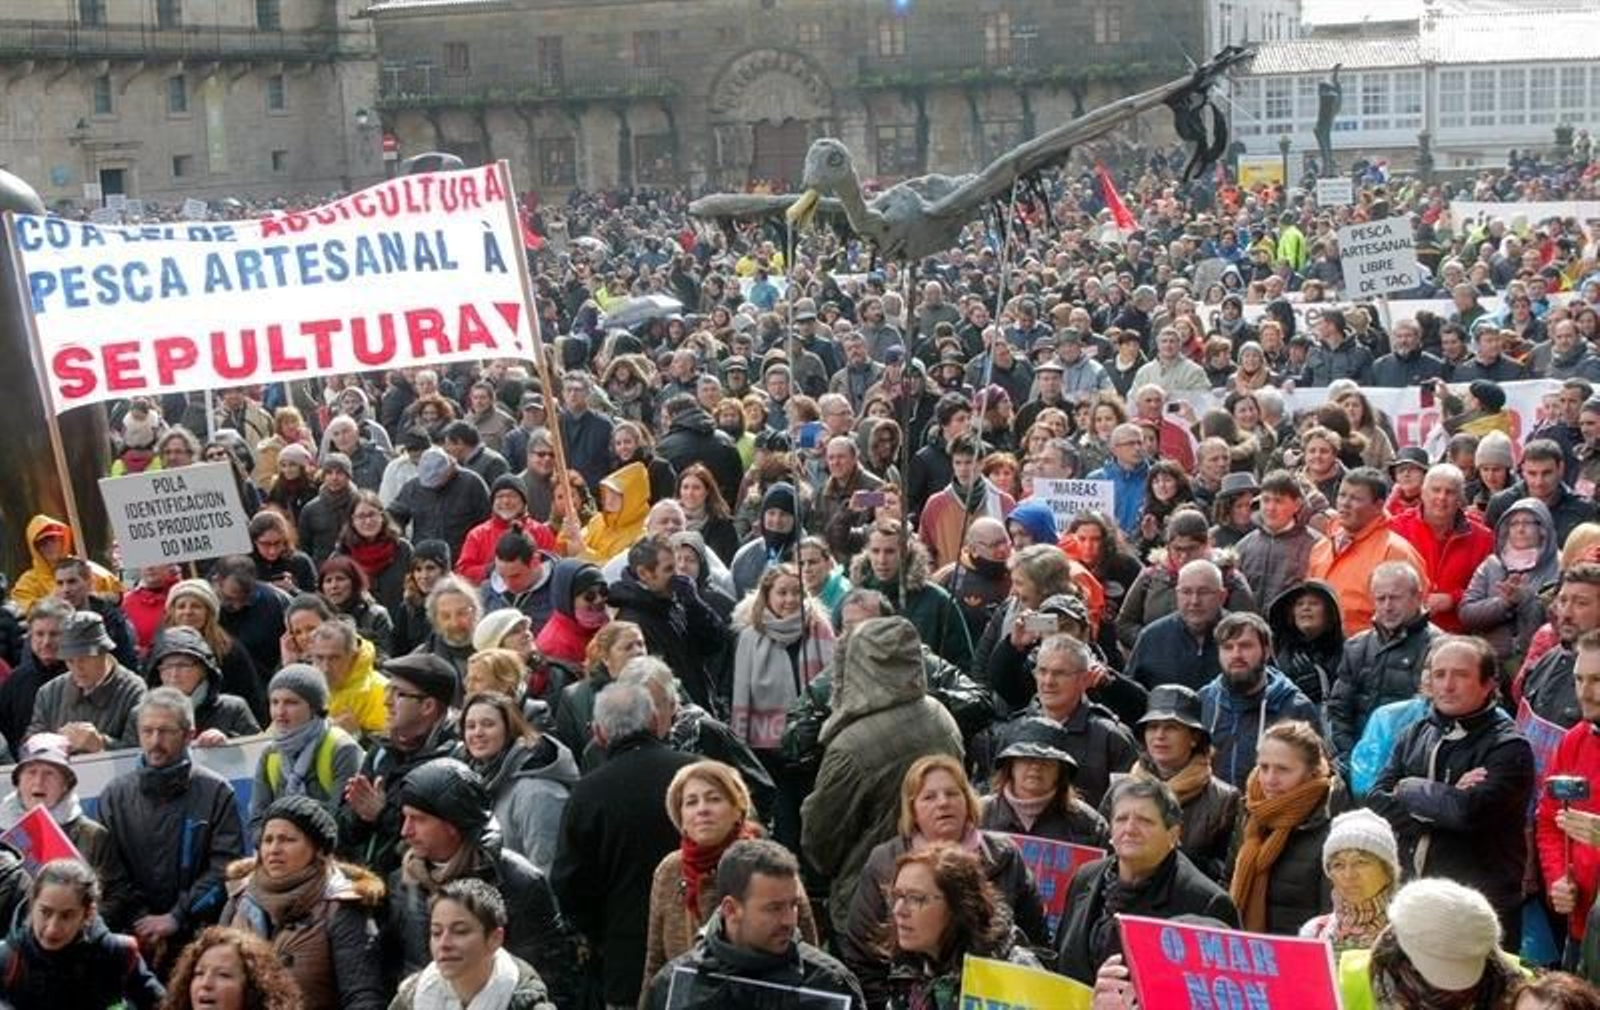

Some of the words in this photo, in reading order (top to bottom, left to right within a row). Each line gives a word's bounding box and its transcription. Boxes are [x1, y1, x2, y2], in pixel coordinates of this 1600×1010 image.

[81, 224, 106, 247] A
[1351, 224, 1393, 241] PESCA
[1341, 238, 1414, 257] ARTESANAL
[28, 256, 189, 314] PESCA
[204, 230, 459, 294] ARTESANAL
[482, 220, 508, 274] À
[1361, 259, 1394, 274] LIBRE
[1360, 279, 1376, 292] DE
[52, 302, 521, 399] SEPULTURA!
[152, 475, 188, 495] POLA
[128, 522, 156, 540] DOS
[157, 511, 234, 536] PRODUCTOS
[161, 540, 180, 557] DO
[181, 535, 212, 552] MAR
[1160, 926, 1186, 965] O
[1196, 931, 1279, 976] MAR
[1183, 971, 1271, 1010] NON
